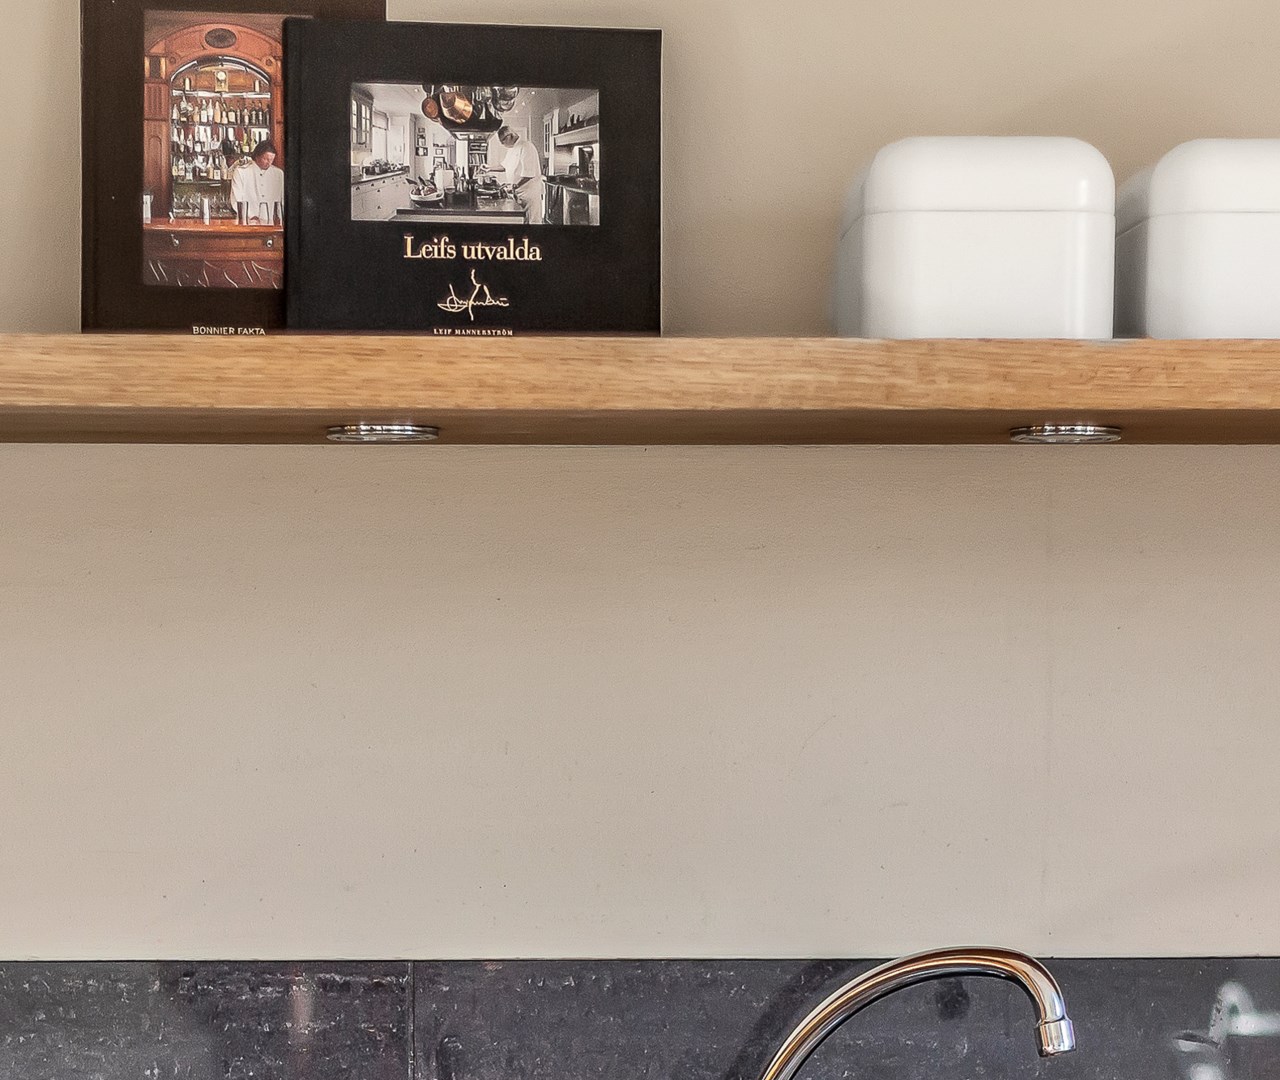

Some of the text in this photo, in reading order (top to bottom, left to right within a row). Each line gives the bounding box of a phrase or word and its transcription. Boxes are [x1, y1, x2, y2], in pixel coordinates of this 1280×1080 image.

[404, 236, 542, 261] Leifs utvalda
[193, 326, 266, 335] BONNIER FAKTA
